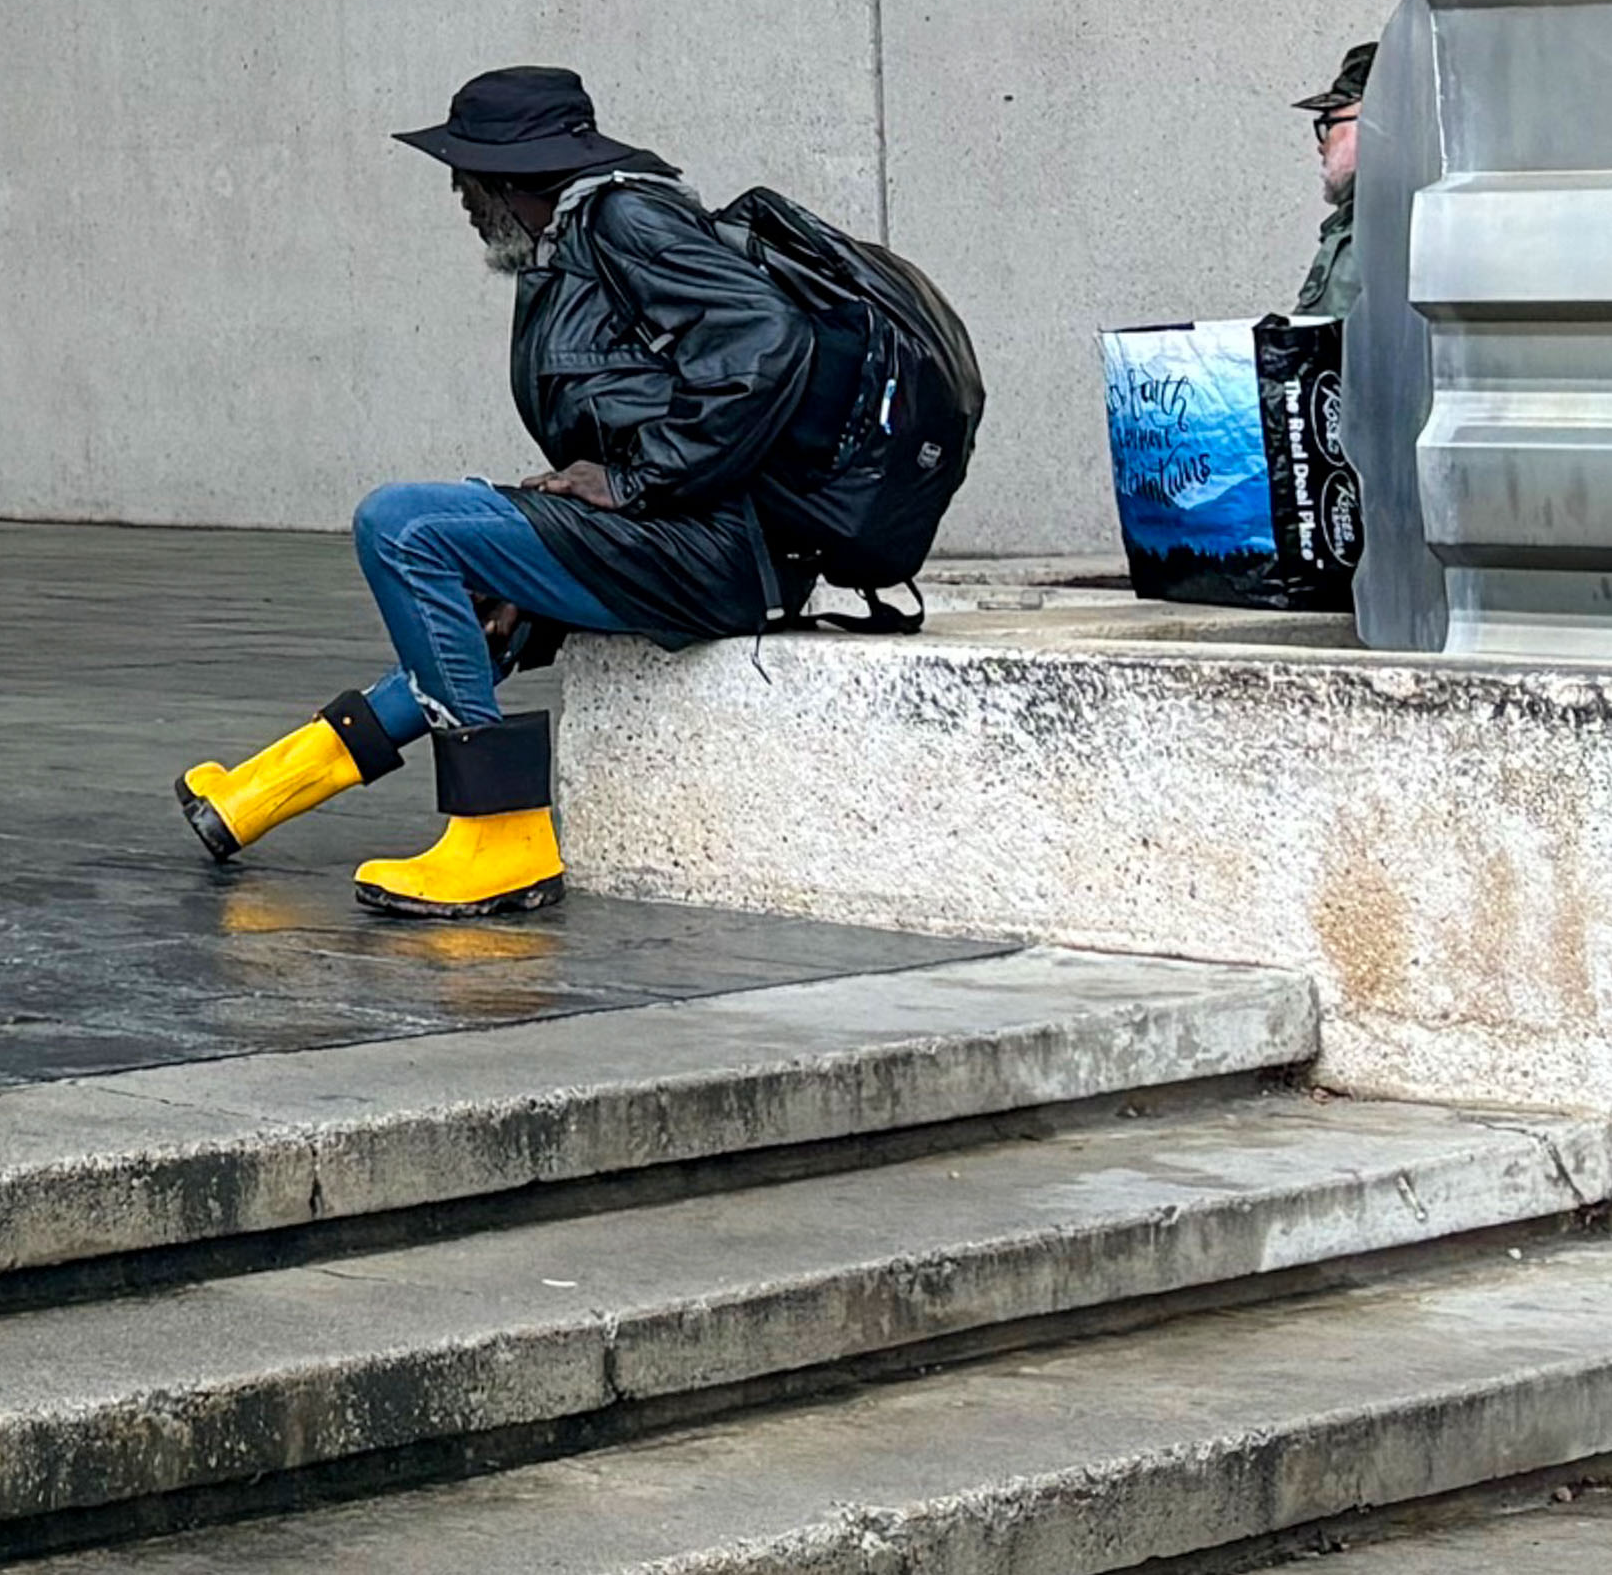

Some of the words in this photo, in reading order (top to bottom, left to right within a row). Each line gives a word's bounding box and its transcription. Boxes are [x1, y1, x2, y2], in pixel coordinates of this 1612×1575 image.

[1284, 378, 1301, 414] The
[1288, 418, 1309, 460] Real
[1293, 463, 1314, 507] Deal
[1298, 510, 1317, 561] Place
